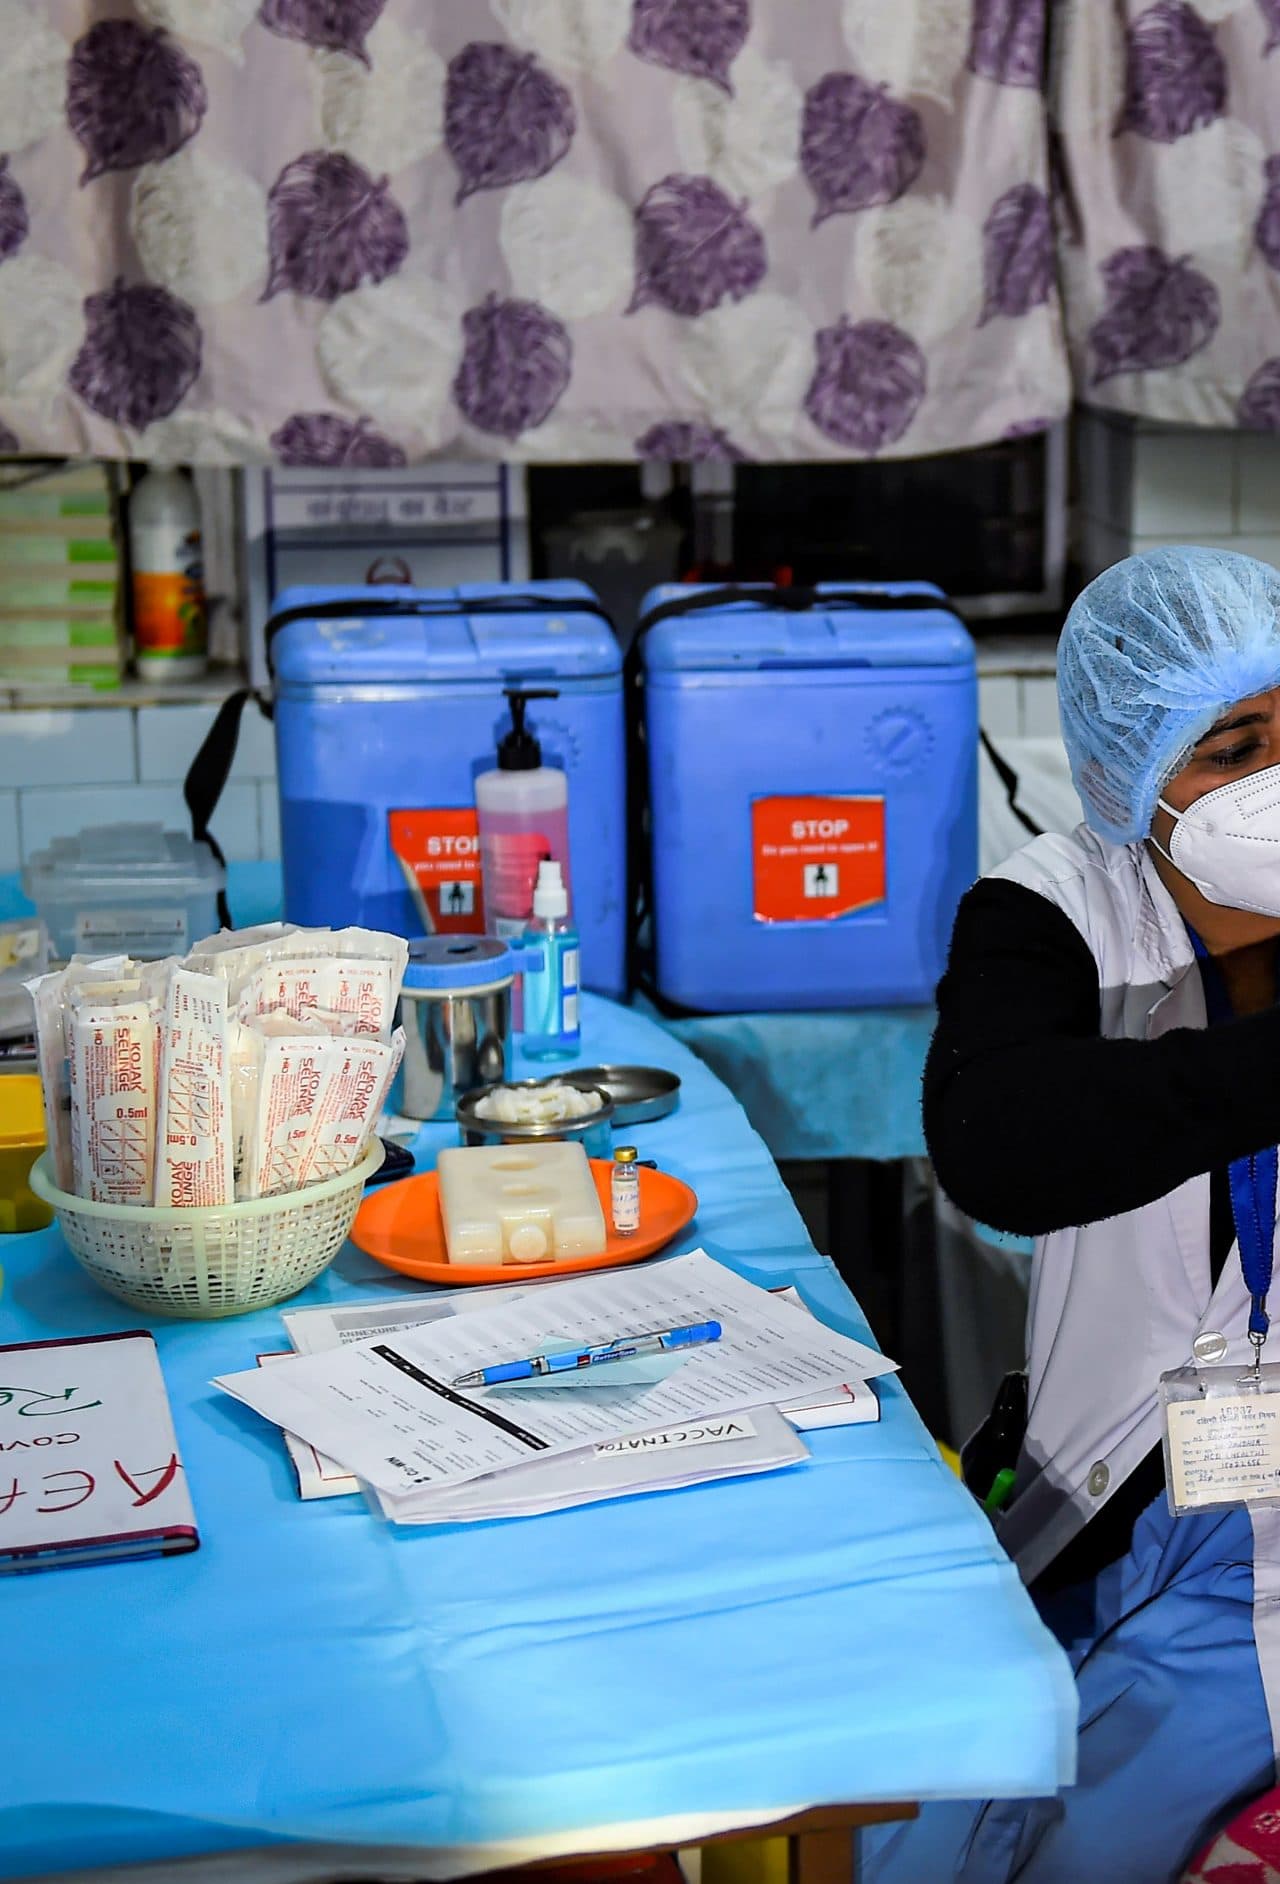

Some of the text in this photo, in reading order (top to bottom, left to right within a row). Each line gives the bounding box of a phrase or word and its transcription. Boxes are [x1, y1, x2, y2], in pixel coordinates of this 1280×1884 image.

[791, 820, 849, 838] STOP
[369, 996, 383, 1034] KOJA
[117, 1028, 131, 1092] SELINGE
[131, 1042, 142, 1092] KOJAK
[294, 1058, 313, 1116] SELINGE
[304, 1071, 321, 1116] KOJAK
[350, 1061, 373, 1120] SELINGE
[357, 1075, 378, 1122] KOJAK
[116, 1107, 148, 1119] 0.5ml
[167, 1134, 197, 1146] 0.5ml
[334, 1133, 360, 1144] 0.5ml
[171, 1161, 184, 1208] KOJAK
[339, 1326, 401, 1338] ANNEXURE
[595, 1423, 743, 1452] VACCINATOR
